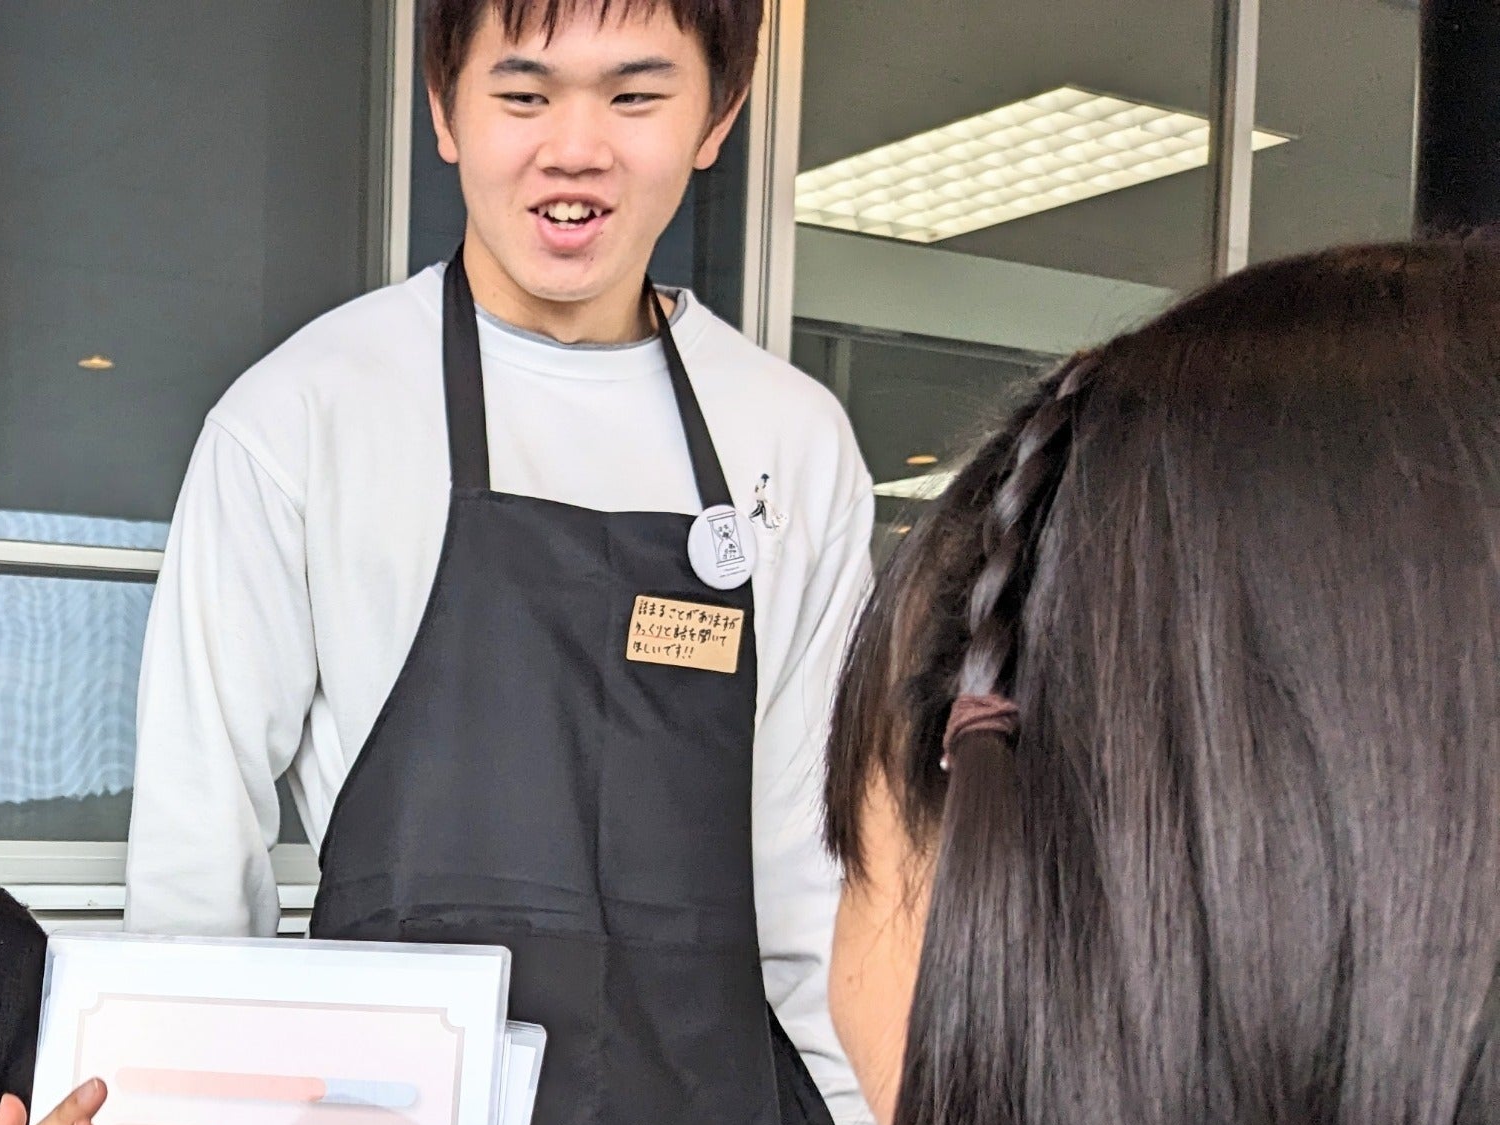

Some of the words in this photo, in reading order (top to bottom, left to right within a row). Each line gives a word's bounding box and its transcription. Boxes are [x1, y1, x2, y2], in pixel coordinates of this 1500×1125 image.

[634, 621, 727, 647] ゆっくりと話を聞いて
